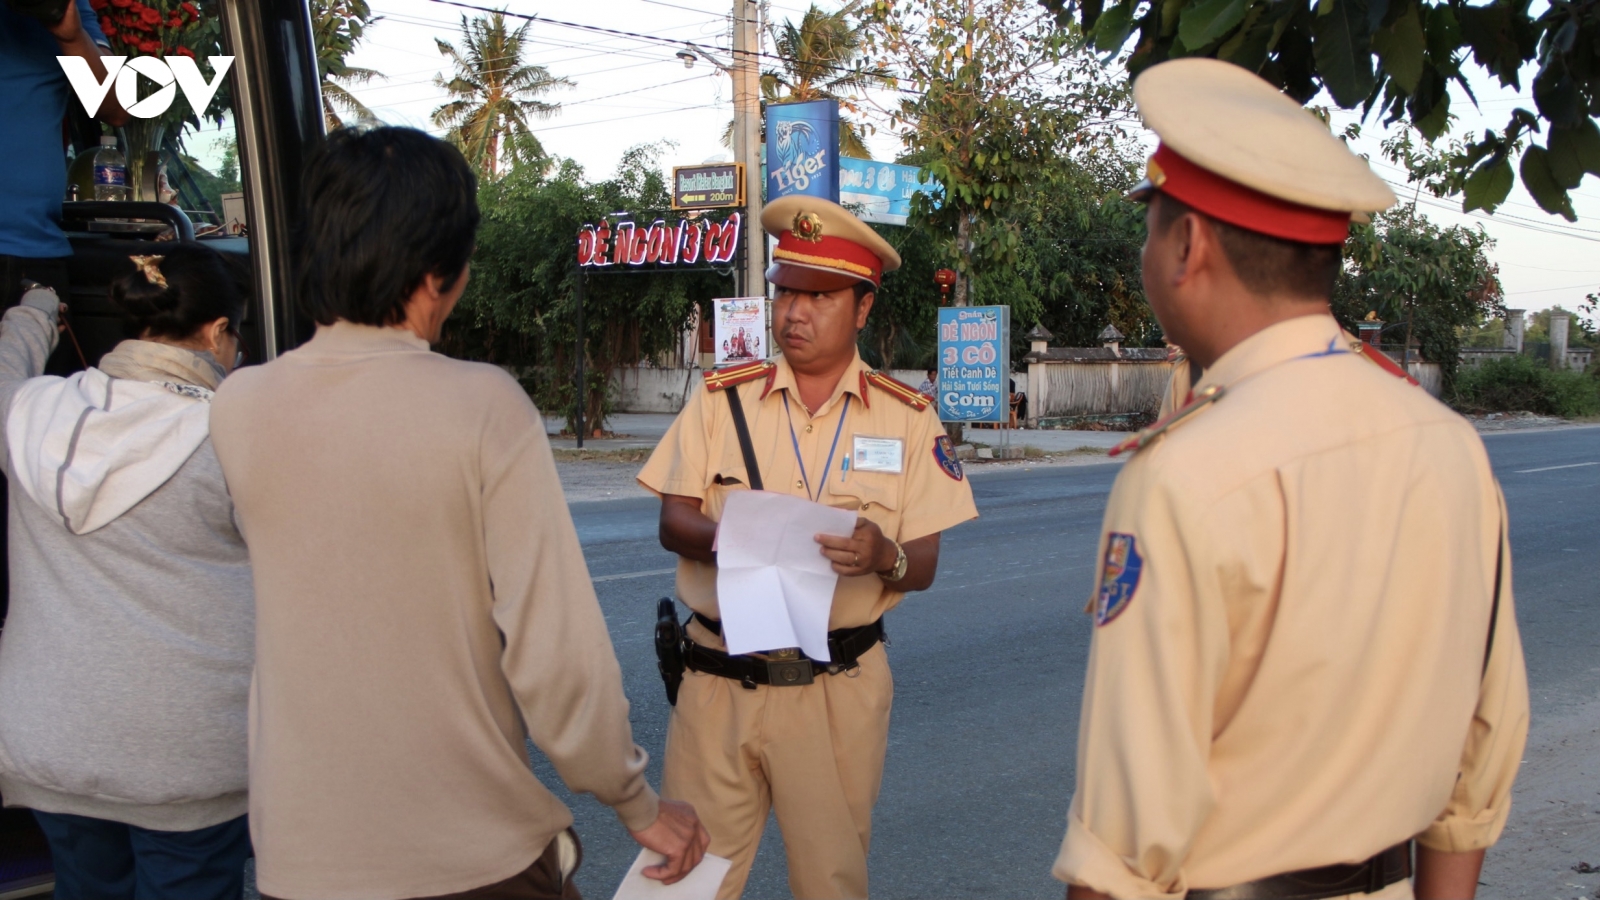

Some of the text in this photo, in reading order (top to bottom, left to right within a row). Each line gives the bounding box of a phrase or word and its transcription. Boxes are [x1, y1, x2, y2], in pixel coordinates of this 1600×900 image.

[771, 149, 826, 191] Tiger
[709, 192, 734, 202] 200m
[682, 222, 700, 263] 3
[941, 319, 959, 342] DÊ
[943, 342, 996, 365] 3 CÔ
[942, 365, 997, 379] Tiết Canh Dê
[941, 380, 953, 391] Hải
[953, 380, 966, 391] Sản
[983, 379, 1000, 393] Sống
[943, 391, 995, 407] Cơm
